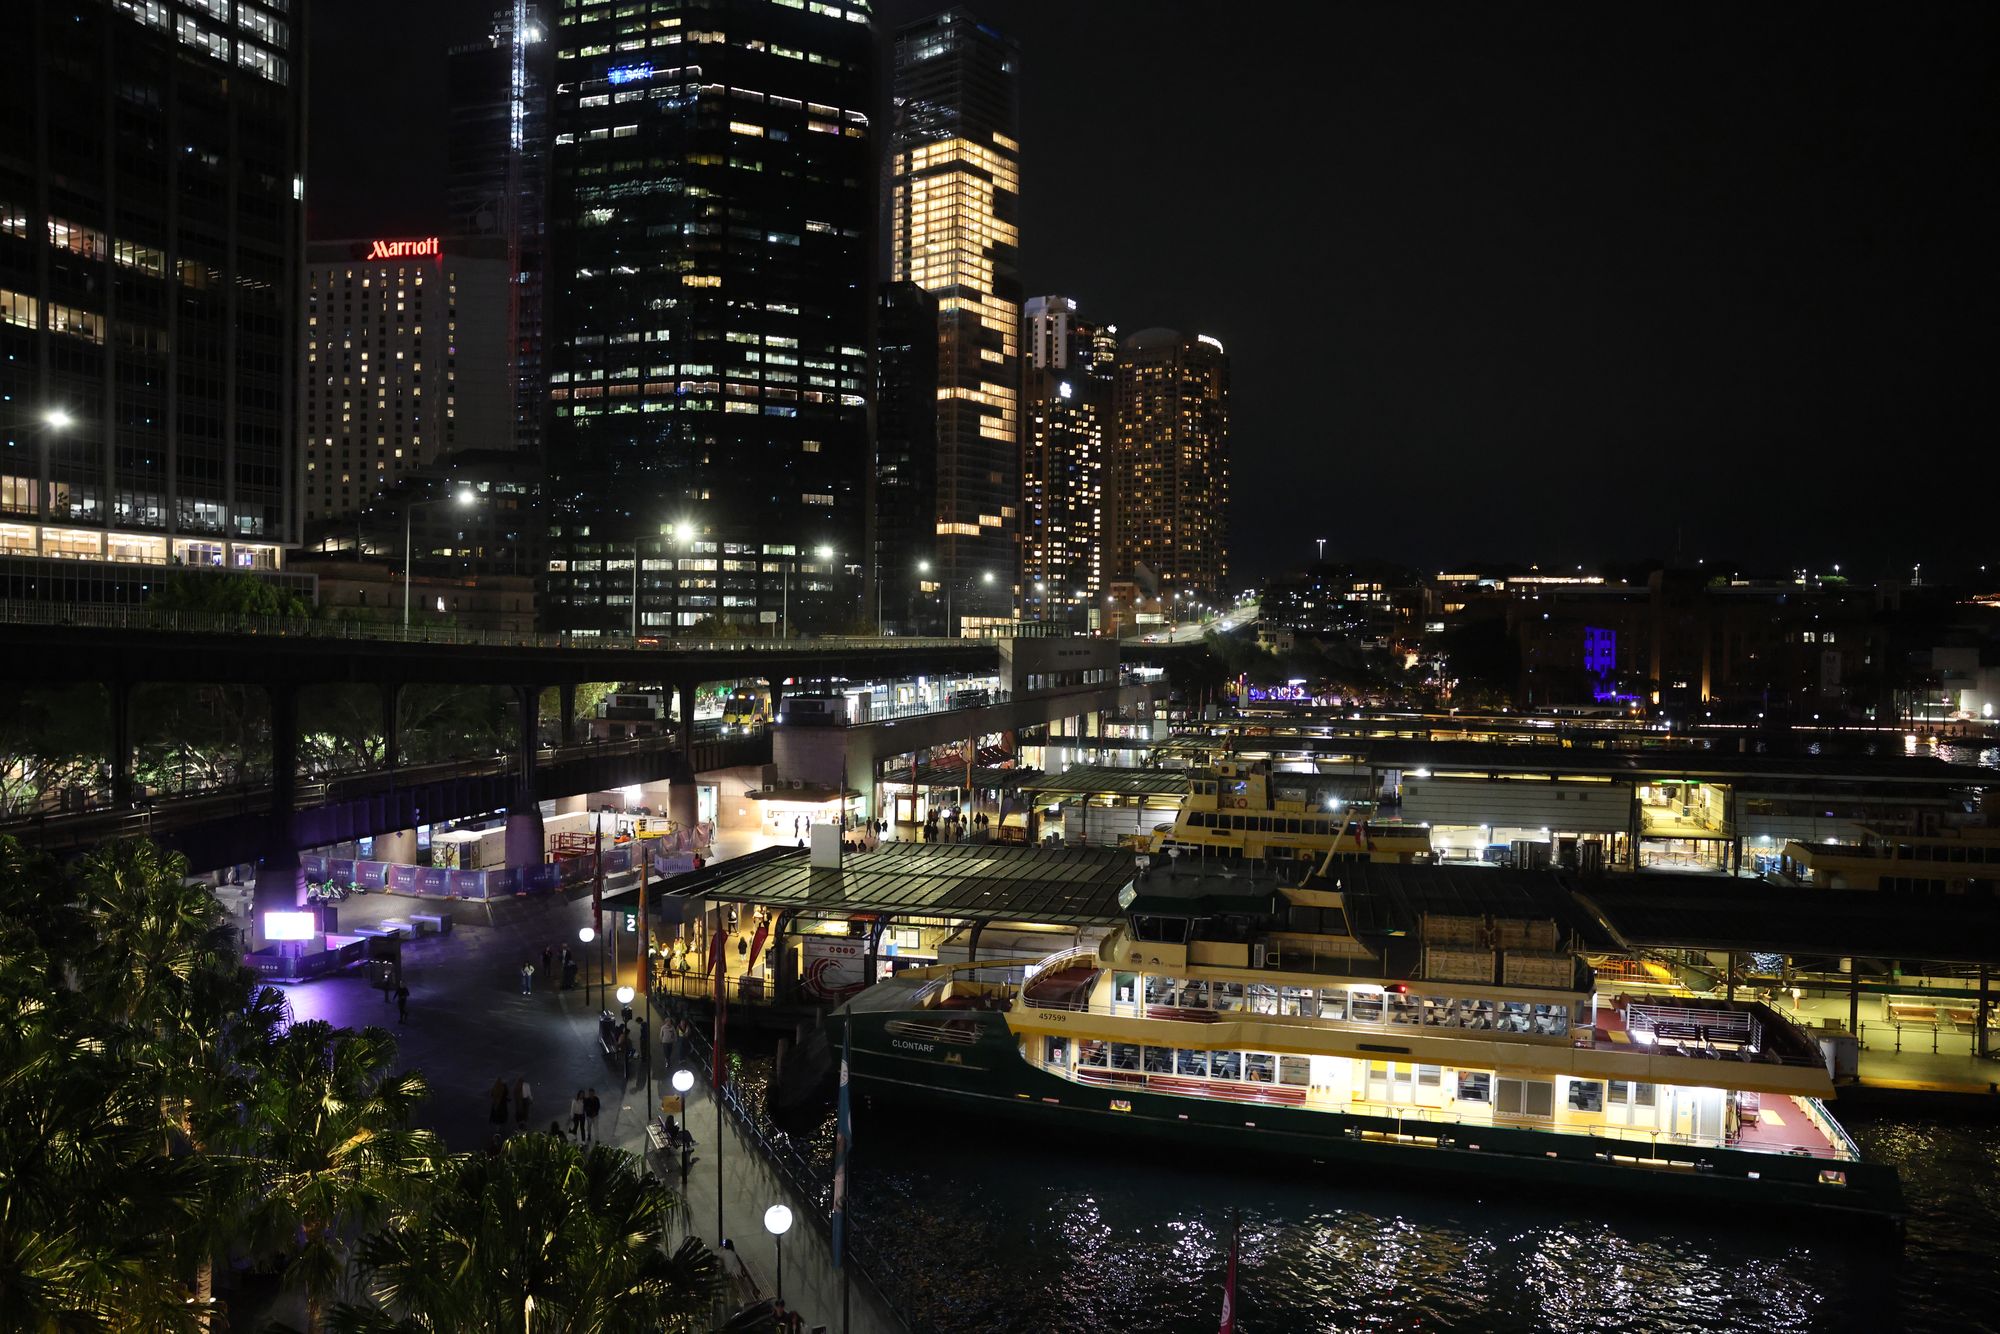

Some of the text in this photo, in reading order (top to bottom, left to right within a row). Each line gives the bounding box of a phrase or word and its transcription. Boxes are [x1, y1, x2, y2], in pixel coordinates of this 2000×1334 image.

[367, 238, 439, 259] Marriott
[626, 918, 636, 932] 2
[1039, 1013, 1066, 1022] 457599
[892, 1039, 935, 1053] CLONTARF
